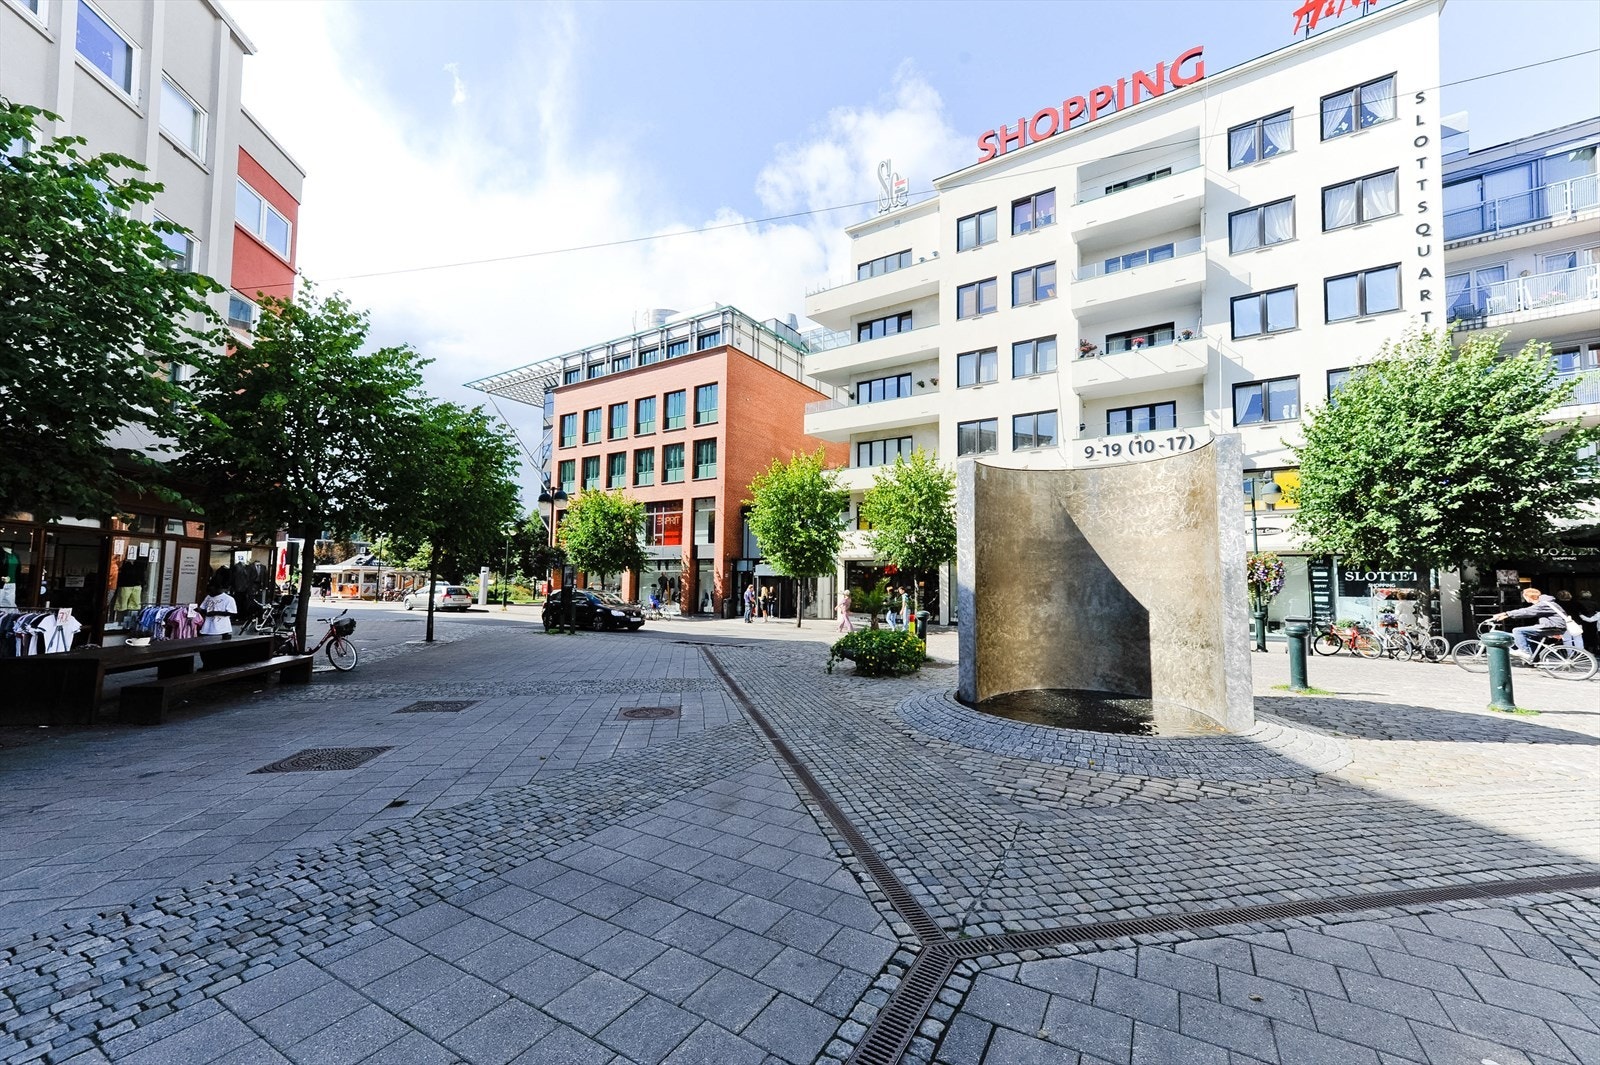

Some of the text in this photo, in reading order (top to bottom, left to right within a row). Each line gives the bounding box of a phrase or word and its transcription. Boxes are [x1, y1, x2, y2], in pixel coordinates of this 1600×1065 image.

[977, 45, 1204, 163] SHOPPING
[1413, 91, 1433, 323] SLOTTSQUART
[1084, 443, 1122, 459] 9-19
[656, 516, 681, 526] EPRIT
